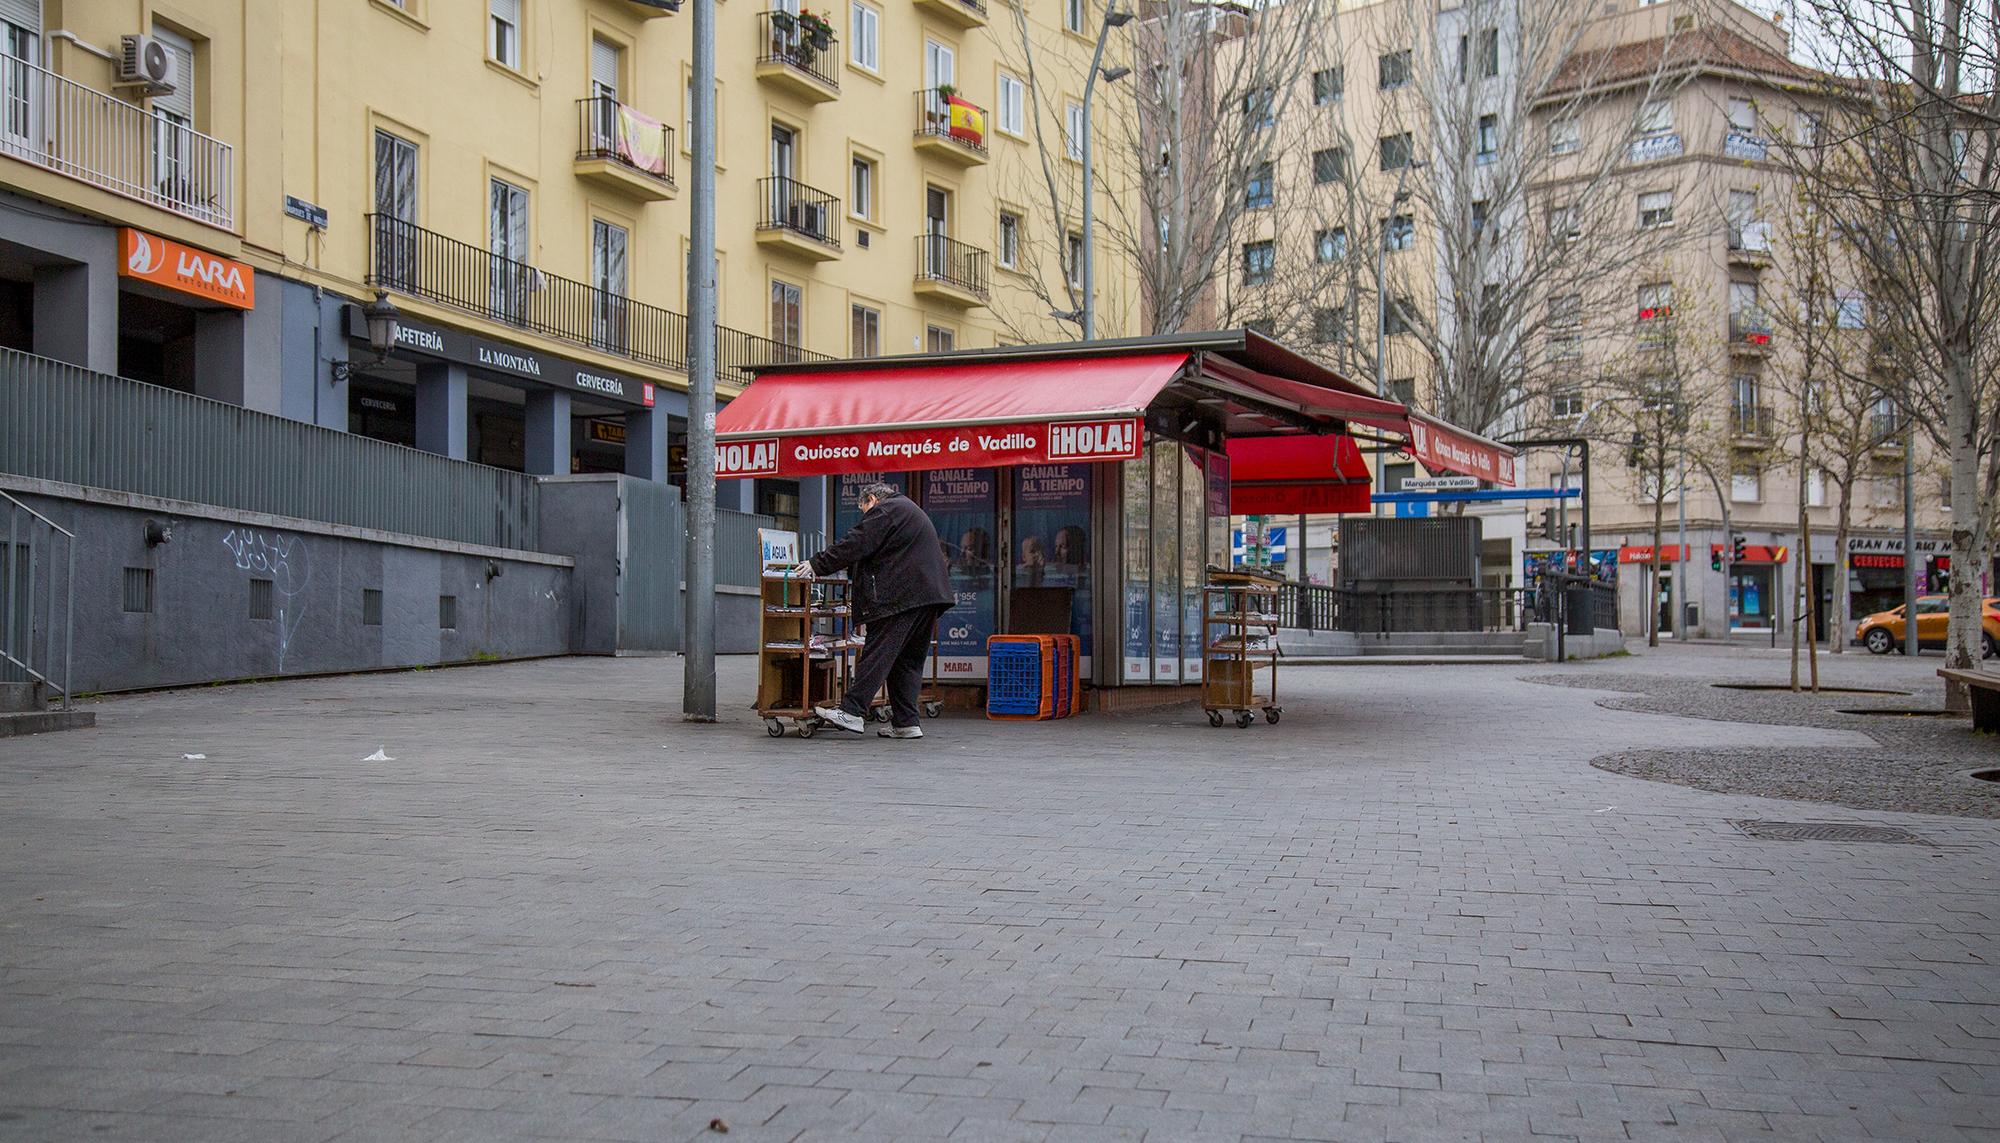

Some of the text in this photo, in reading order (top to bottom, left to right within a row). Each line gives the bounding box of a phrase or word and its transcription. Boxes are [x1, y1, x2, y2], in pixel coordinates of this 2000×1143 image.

[177, 251, 246, 293] LARA
[177, 275, 247, 300] AUTOESCUELA
[394, 325, 443, 352] AFETERÍA
[479, 348, 541, 375] LA MONTAÑA
[576, 371, 624, 396] CERVECERÍA
[794, 433, 1037, 461] Quiosco Marqués de Vadillo
[1052, 423, 1133, 455] ¡HOLA!
[714, 442, 777, 472] HOLA!
[929, 481, 989, 495] AL TIEMPO
[1022, 478, 1085, 492] AL TIEMPO
[1449, 478, 1475, 486] Vadillo
[771, 545, 787, 560] AGUA
[1848, 539, 1881, 551] GRAN
[948, 627, 969, 639] GO
[944, 662, 973, 672] MARCA
